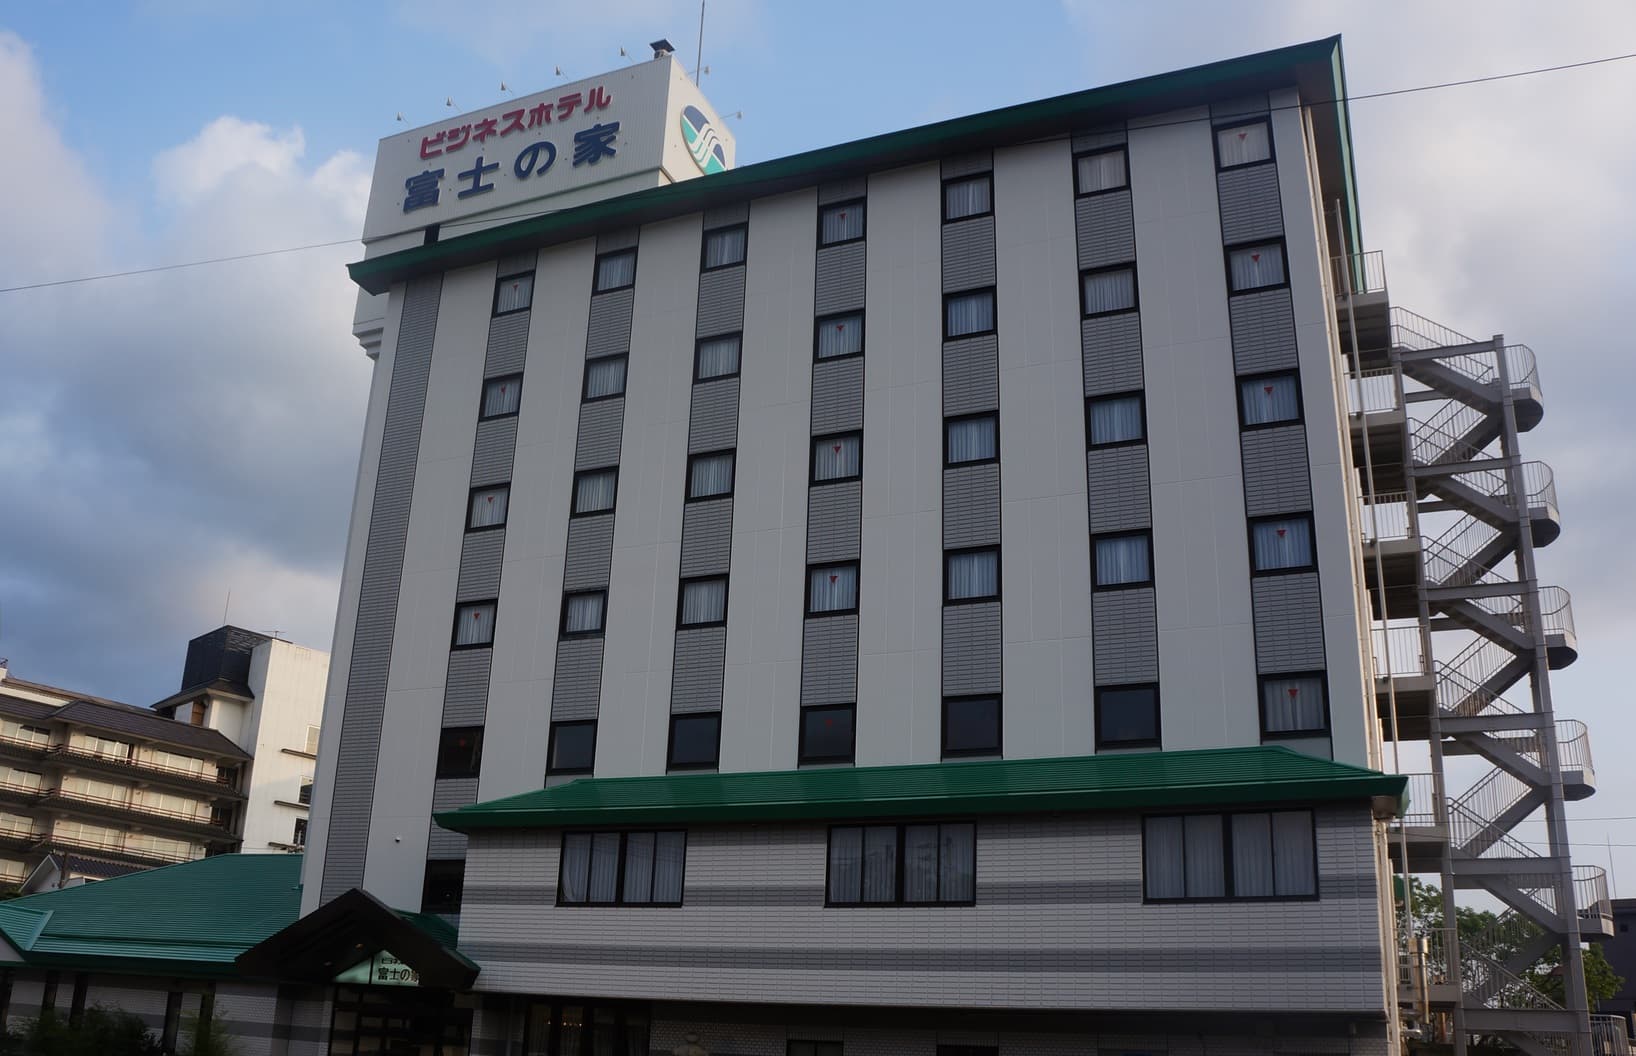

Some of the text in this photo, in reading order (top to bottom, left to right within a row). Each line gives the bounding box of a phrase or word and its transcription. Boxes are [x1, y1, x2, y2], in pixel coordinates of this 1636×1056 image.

[421, 87, 611, 158] ビジネスホテル
[403, 121, 620, 212] 富士の家
